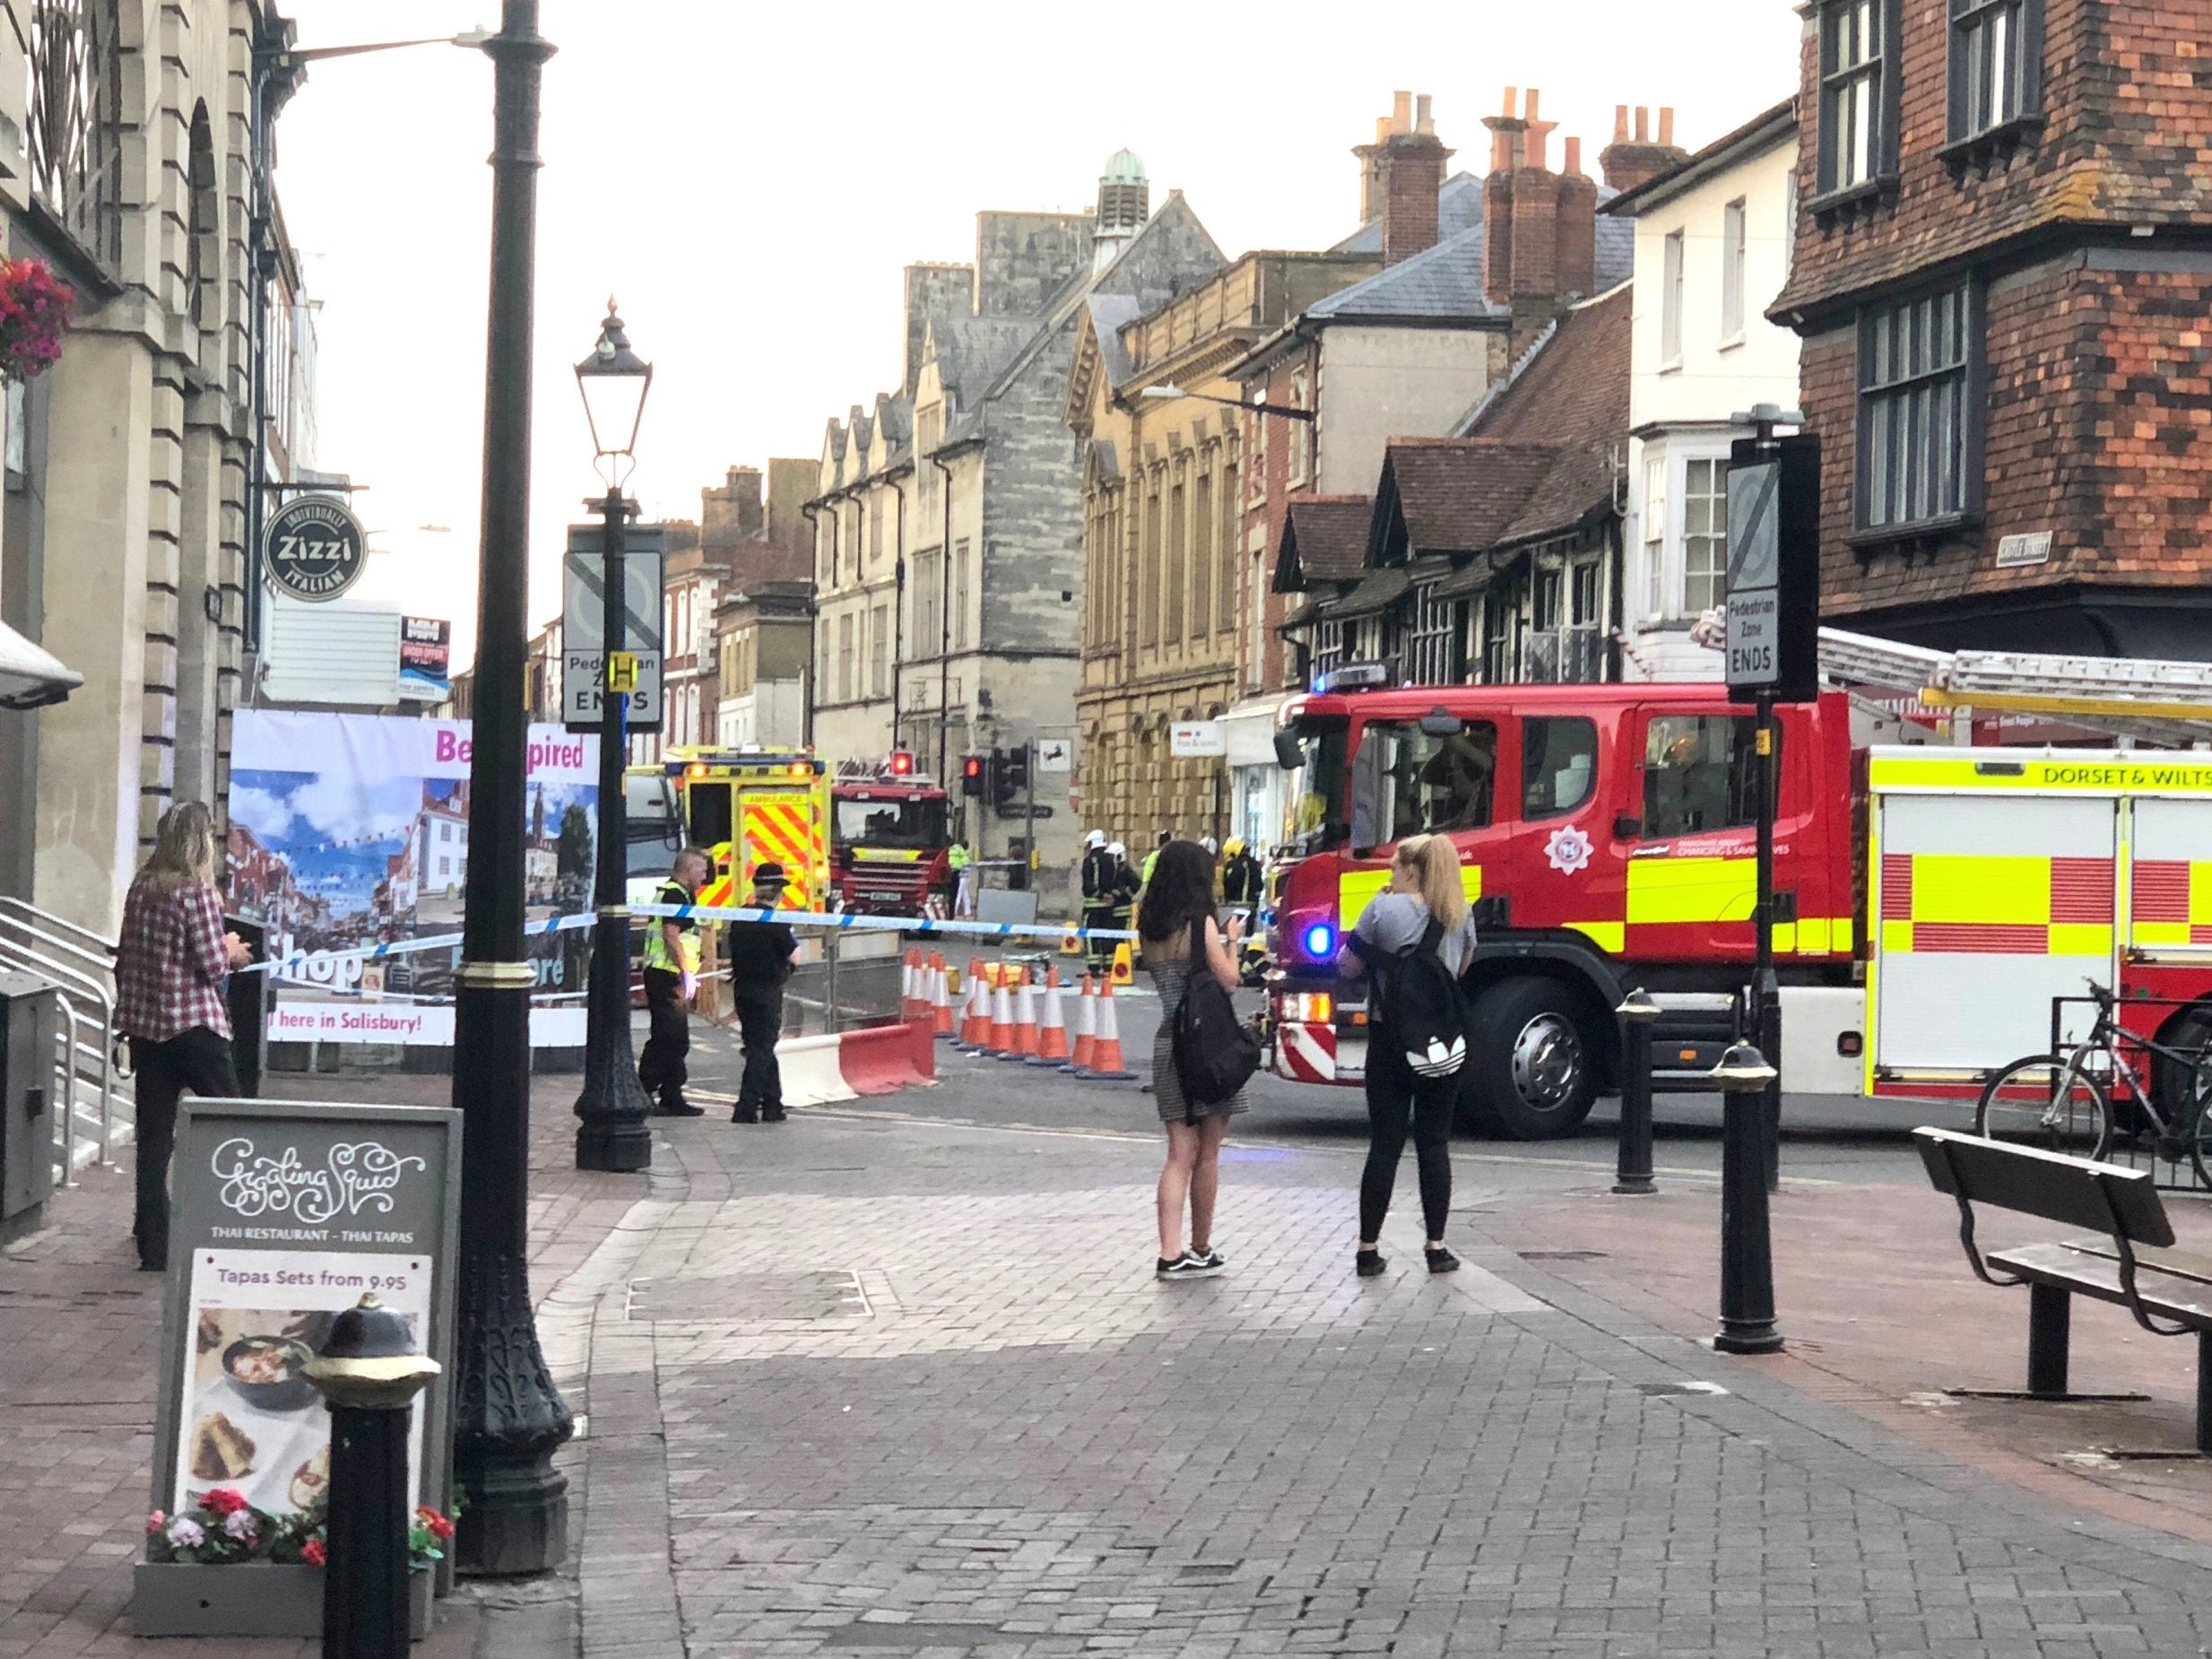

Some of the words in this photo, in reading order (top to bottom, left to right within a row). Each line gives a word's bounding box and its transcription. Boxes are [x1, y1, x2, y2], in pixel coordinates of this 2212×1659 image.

[283, 506, 348, 528] INDIVIDUALLY
[277, 535, 351, 561] Zizzi
[284, 569, 346, 592] ITALIAN
[1729, 599, 1774, 618] Pedestrian
[1741, 621, 1762, 638] Zone
[1732, 646, 1771, 673] ENDS
[614, 656, 632, 688] H
[576, 691, 648, 710] ENS
[437, 730, 472, 763] Be
[527, 734, 583, 774] pired
[2044, 768, 2128, 784] DORSET
[2131, 769, 2146, 785] &
[750, 795, 802, 803] AMBULANCE
[280, 1011, 314, 1028] here
[321, 1012, 335, 1028] in
[341, 1012, 421, 1034] Salisbury!
[212, 1138, 334, 1223] Giggling
[327, 1142, 426, 1217] Squid
[211, 1226, 242, 1238] THAI
[246, 1228, 329, 1241] RESTAURANT
[342, 1230, 372, 1242] THAI
[376, 1231, 414, 1244] TAPAS
[218, 1268, 270, 1286] Tapas
[276, 1270, 314, 1285] Sets
[320, 1272, 363, 1287] from
[369, 1274, 407, 1290] 9.95
